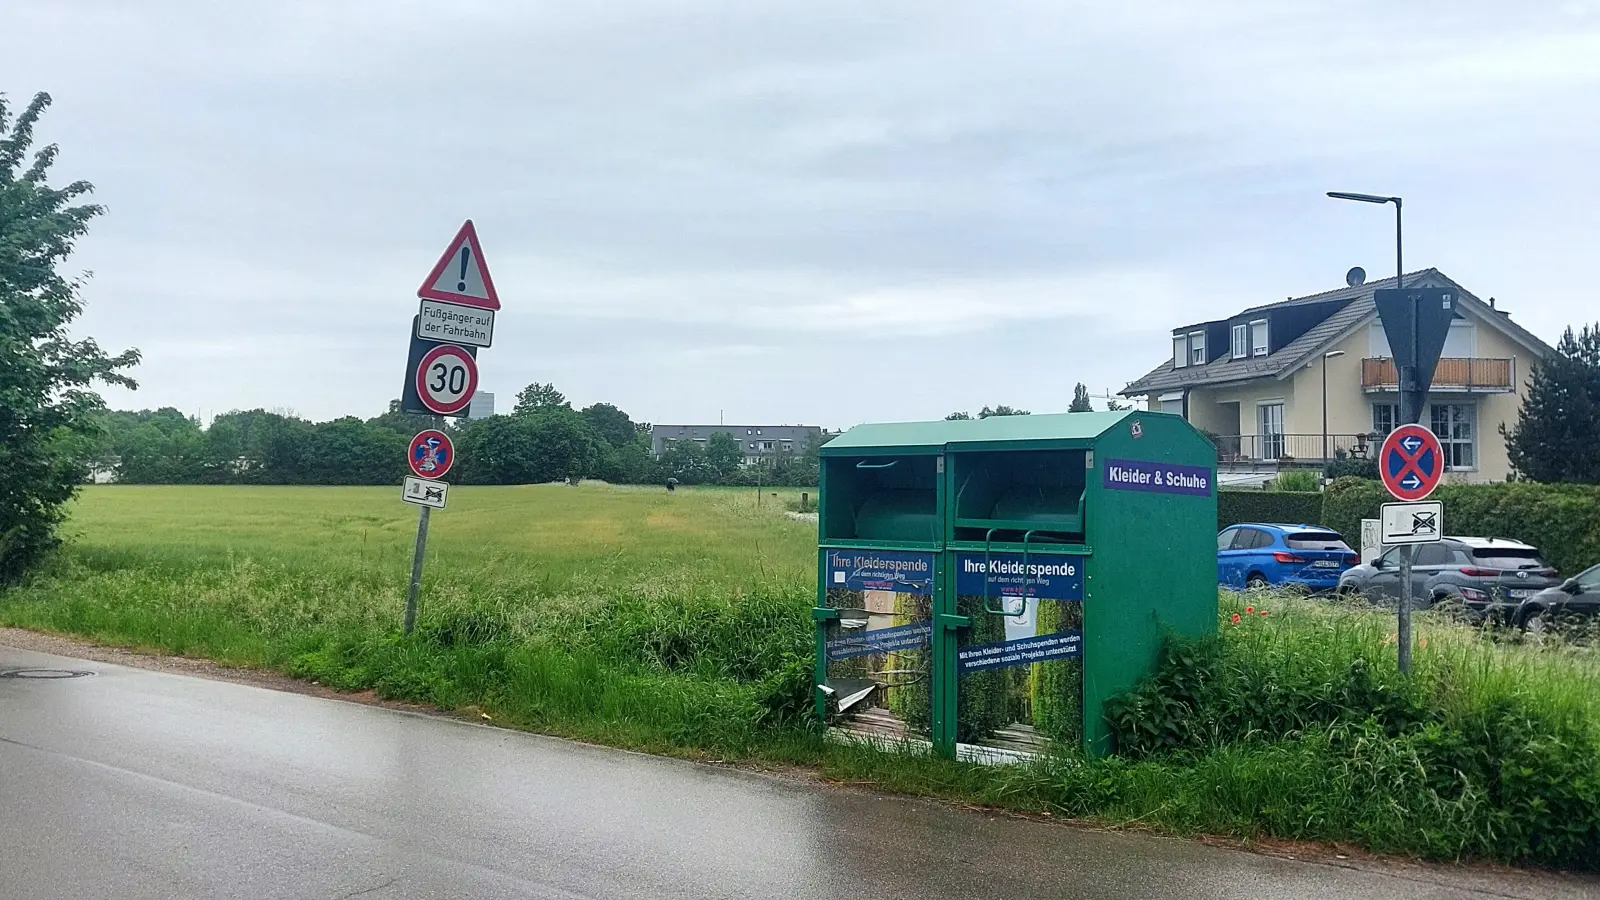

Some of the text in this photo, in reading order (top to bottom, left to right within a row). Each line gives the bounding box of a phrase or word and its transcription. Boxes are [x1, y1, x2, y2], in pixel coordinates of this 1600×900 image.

[424, 307, 490, 326] Fußgänger auf
[425, 322, 485, 339] der Fahrbahn
[430, 363, 465, 394] 30
[1109, 466, 1206, 489] Kleider & Schuhe
[833, 555, 928, 573] Ihre Kleiderspende
[964, 559, 1075, 577] Ihre Kleiderspende
[1036, 577, 1049, 586] Weg
[959, 651, 968, 659] Mit
[968, 649, 982, 658] Ihren
[982, 646, 1004, 656] Kleider-
[1016, 638, 1059, 650] Schuhspenden
[1059, 635, 1080, 643] werden
[964, 645, 1077, 668] verschiedene soziale Projekte unterstützt
